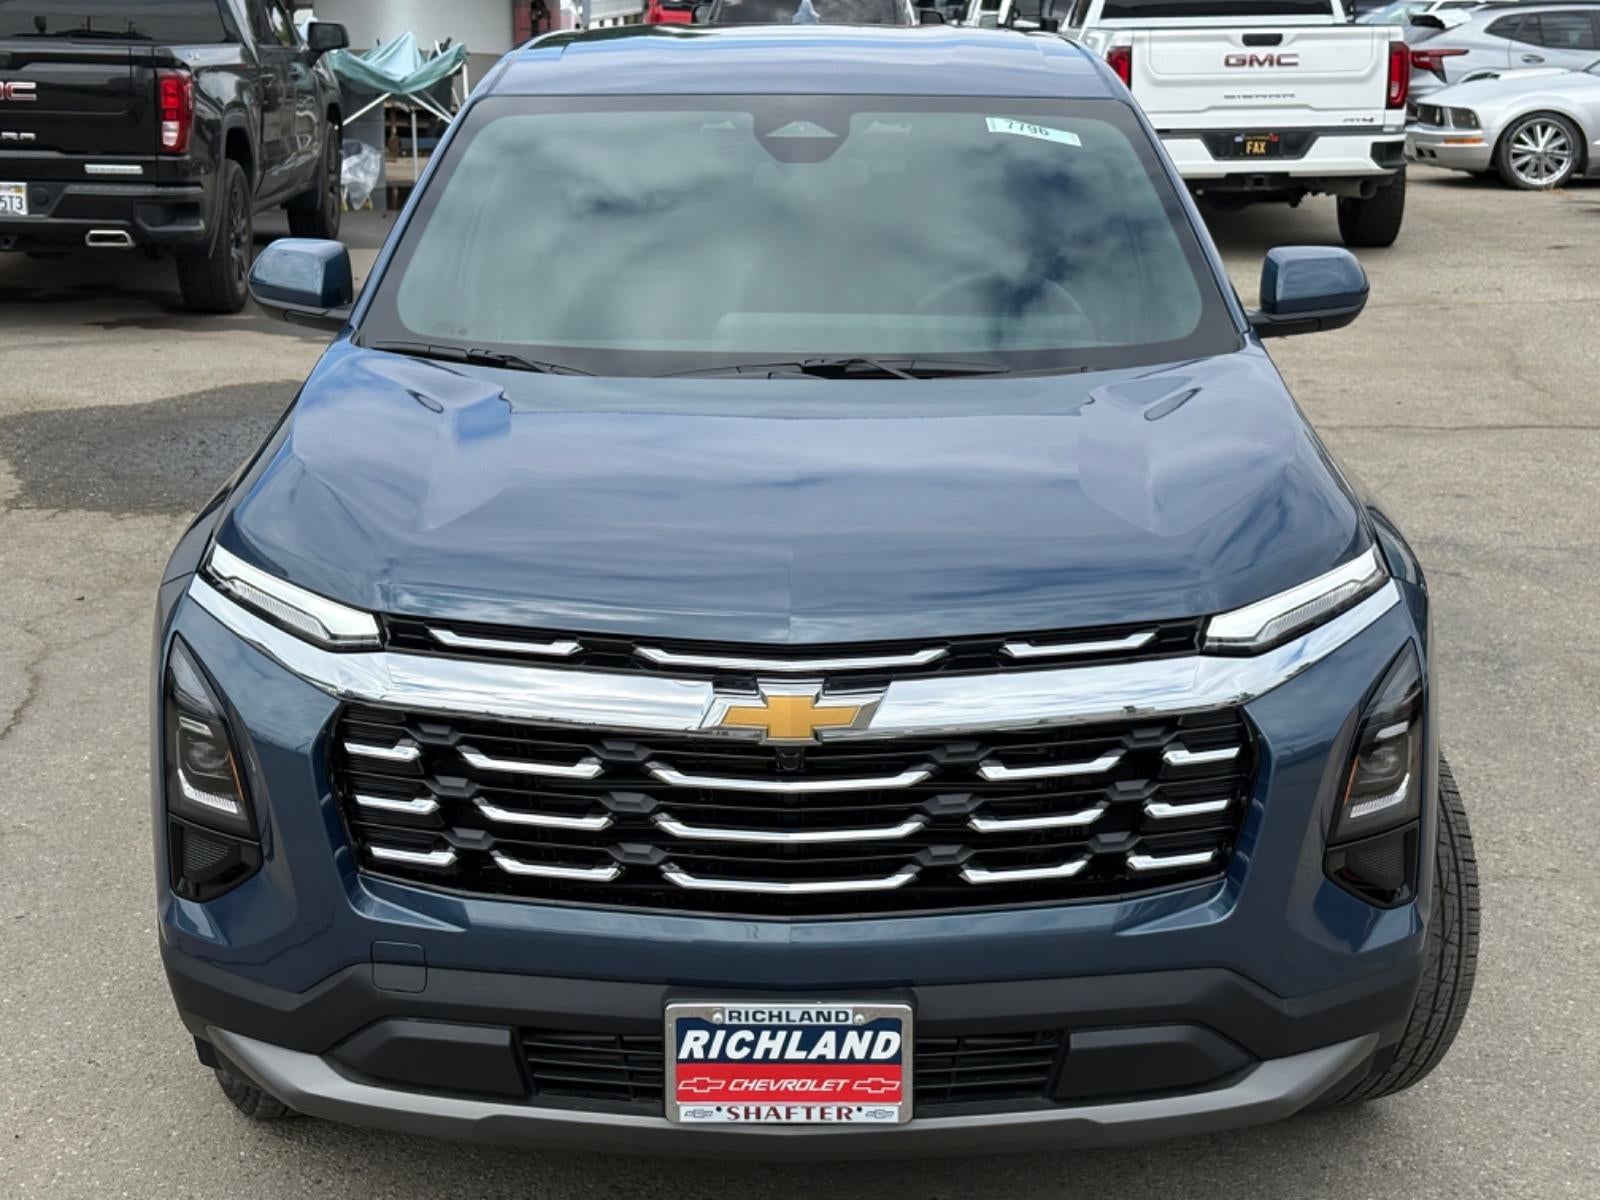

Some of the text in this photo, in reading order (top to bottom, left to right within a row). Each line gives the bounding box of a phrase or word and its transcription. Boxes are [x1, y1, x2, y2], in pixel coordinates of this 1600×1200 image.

[1224, 53, 1299, 67] GMC
[1245, 140, 1267, 155] FAX
[727, 1009, 851, 1023] RICHLAND
[677, 1029, 901, 1060] RICHLAND
[727, 1078, 851, 1092] CHEVROLET
[726, 1105, 853, 1121] SHAFTER
